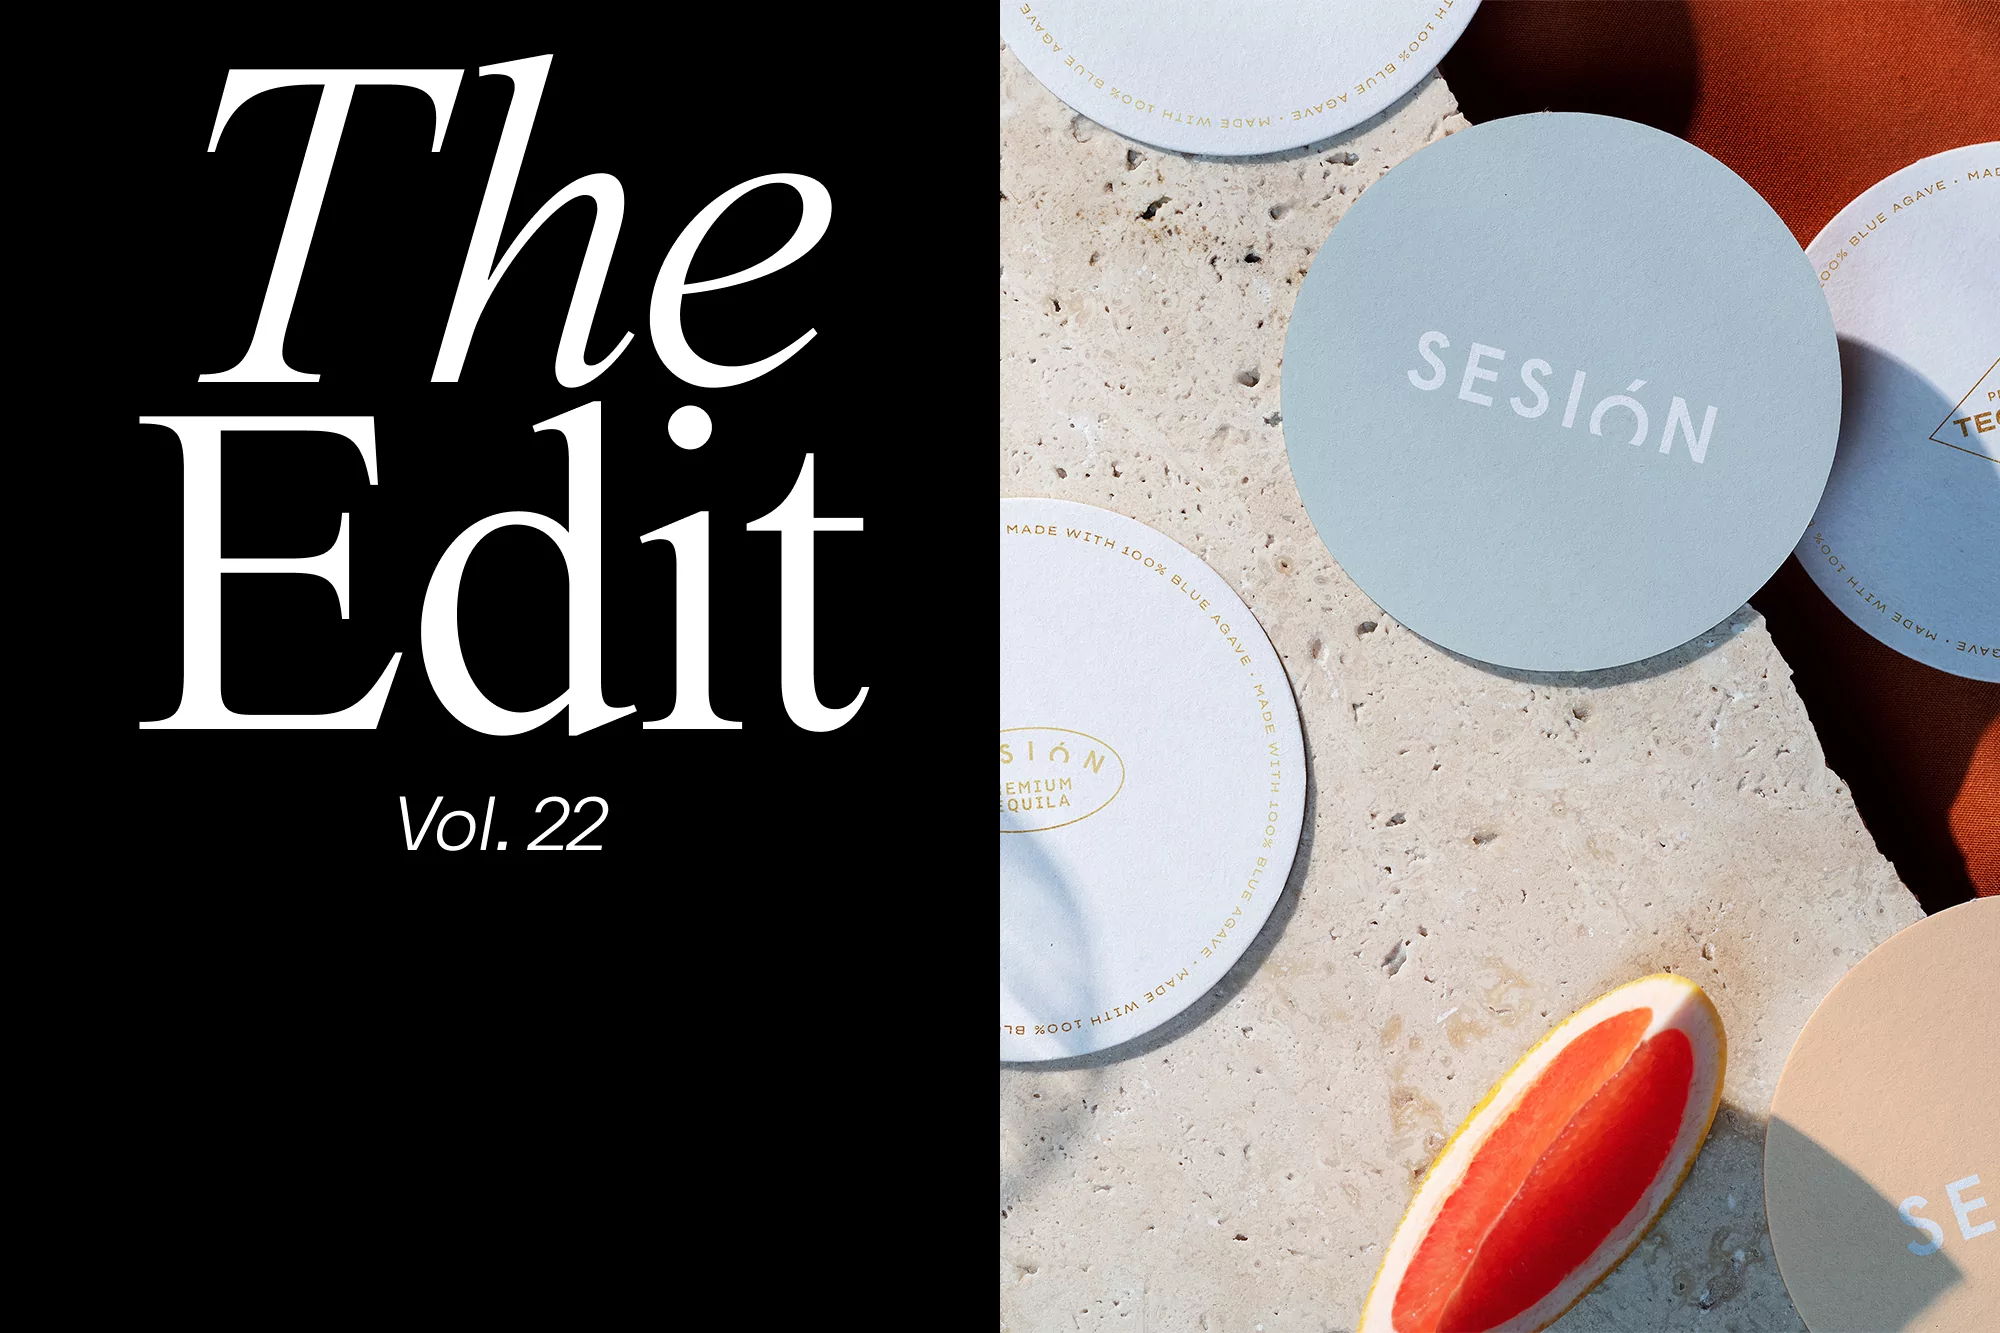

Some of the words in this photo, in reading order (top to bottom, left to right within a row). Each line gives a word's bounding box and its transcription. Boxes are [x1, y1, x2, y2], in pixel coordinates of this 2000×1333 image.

[1020, 4, 1063, 53] AGAVE
[1398, 22, 1435, 63] 100%
[1064, 56, 1105, 90] BLUE
[1354, 63, 1397, 96] BLUE
[1110, 87, 1156, 114] 100%
[1291, 93, 1348, 121] AGAVE
[1162, 110, 1212, 128] WITH
[1221, 117, 1271, 129] MADE
[1820, 249, 1849, 289] 00%
[1849, 212, 1888, 247] BLUE
[1893, 180, 1947, 214] AGAVE
[1407, 331, 1718, 464] SESIÓN
[1007, 524, 1058, 537] MADE
[1067, 528, 1117, 550] WITH
[1121, 546, 1168, 576] 100%
[1812, 532, 1846, 573] 100%
[1171, 574, 1211, 612] BLUE
[1847, 577, 1887, 614] WITH
[1210, 615, 1252, 667] AGAVE
[1891, 612, 1937, 642] MADE
[1254, 684, 1276, 735] MADE
[1269, 742, 1281, 793] WITH
[1000, 778, 1072, 796] EMIUM
[1263, 801, 1279, 849] 100%
[1241, 857, 1268, 902] BLUE
[1201, 906, 1242, 959] AGAVE
[1143, 968, 1190, 1004] MADE
[1032, 1019, 1082, 1036] 100%
[1090, 1001, 1140, 1027] WITH
[1898, 1174, 1997, 1257] SE
